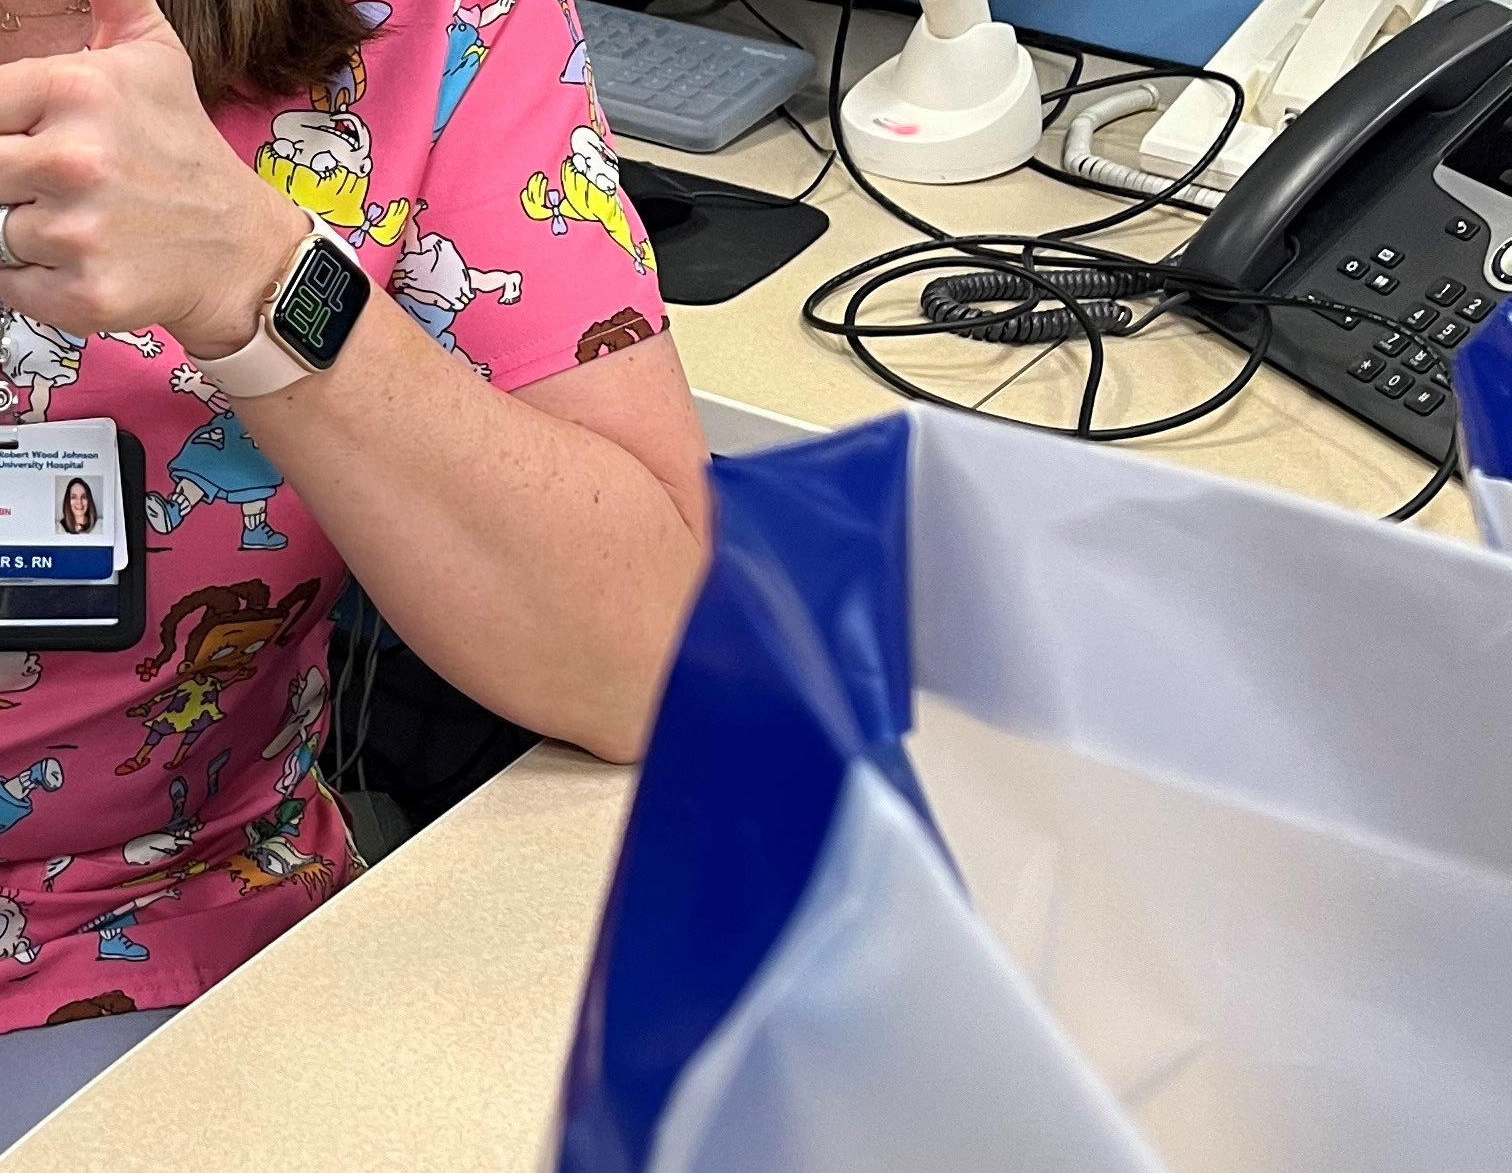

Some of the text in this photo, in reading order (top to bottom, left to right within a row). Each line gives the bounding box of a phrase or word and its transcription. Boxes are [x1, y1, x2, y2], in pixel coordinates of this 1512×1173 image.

[32, 450, 59, 458] Wood
[62, 450, 99, 459] Johnson
[46, 461, 85, 471] Hospital
[14, 556, 29, 568] S.
[31, 556, 53, 568] RN
